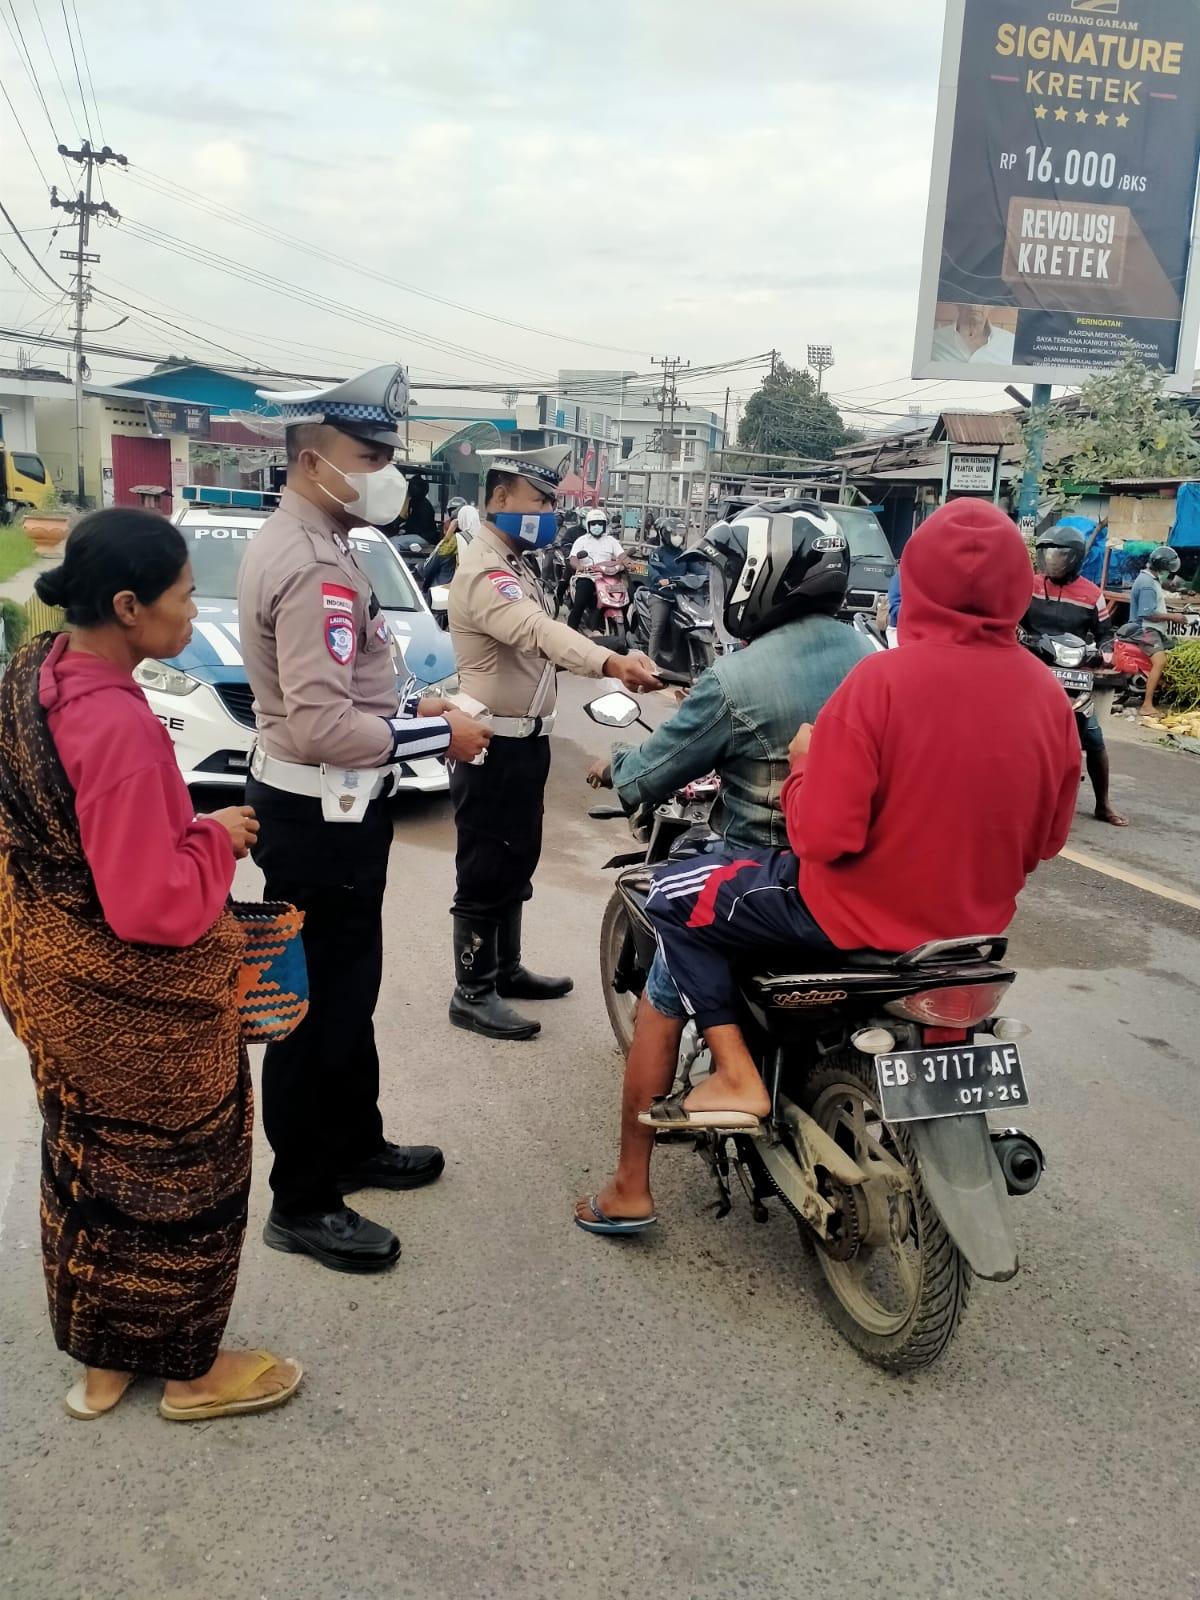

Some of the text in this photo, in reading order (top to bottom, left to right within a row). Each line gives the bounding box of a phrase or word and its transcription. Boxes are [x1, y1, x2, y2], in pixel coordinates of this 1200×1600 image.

[1047, 12, 1139, 31] GUDANG GARAM
[995, 23, 1184, 75] SIGNATURE
[1026, 70, 1142, 105] KRETEK
[1000, 145, 1147, 192] RP 16.000 /BKS
[1021, 208, 1115, 244] REVOLUSI
[1018, 243, 1112, 279] KRETEK
[1023, 519, 1035, 528] WC
[880, 1048, 1017, 1087] EB 3717 AF
